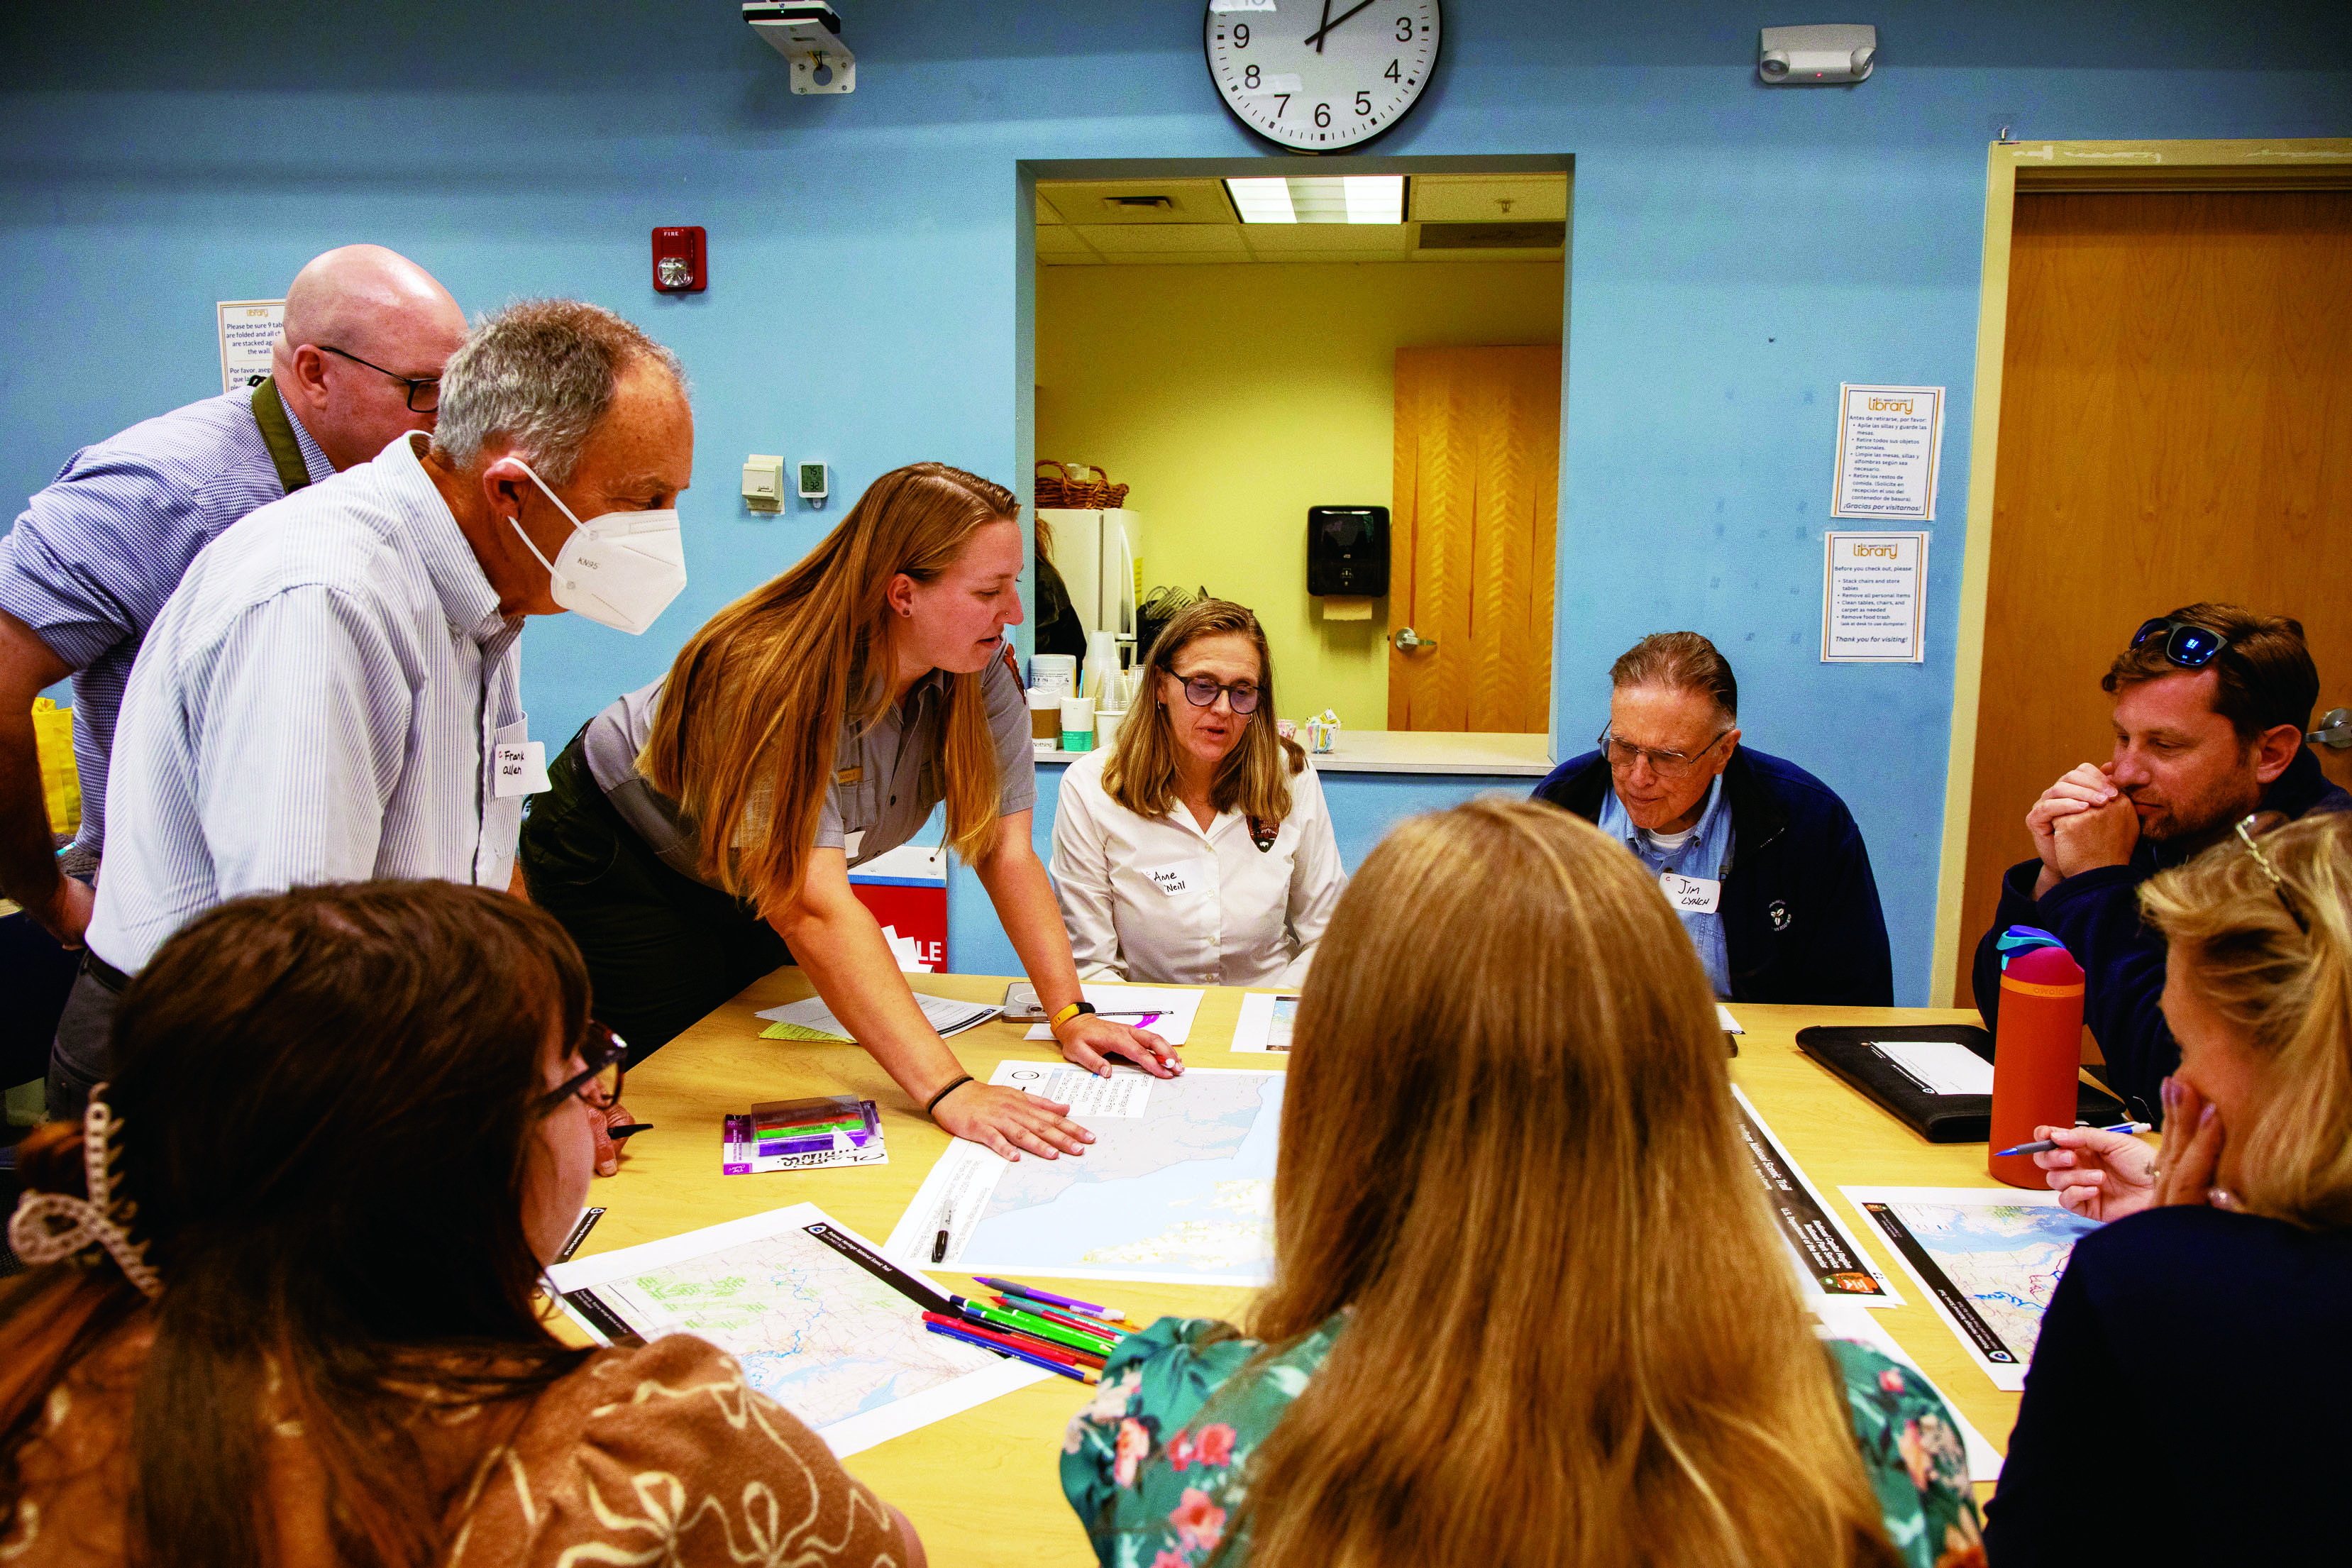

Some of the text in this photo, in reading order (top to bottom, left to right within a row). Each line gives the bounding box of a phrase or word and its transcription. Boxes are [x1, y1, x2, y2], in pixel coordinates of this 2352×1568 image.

[1233, 23, 1250, 49] 9
[1395, 16, 1413, 43] 3
[1244, 64, 1261, 89] 8
[1384, 58, 1402, 84] 4
[1274, 94, 1291, 118] 7
[1314, 103, 1331, 128] 6
[1354, 91, 1371, 116] 5
[246, 309, 268, 318] library
[1868, 397, 1914, 414] library
[808, 467, 817, 475] 75
[577, 556, 599, 570] KN95
[1853, 543, 1898, 560] library
[504, 750, 524, 762] Frank
[1748, 1142, 1771, 1161] National
[1763, 1160, 1781, 1178] Scenic
[1776, 1178, 1793, 1191] Trail
[1787, 1216, 1809, 1240] Department
[1812, 1252, 1828, 1269] Interior
[1804, 1224, 1840, 1269] National Park Service
[1812, 1220, 1853, 1269] National Capital Region
